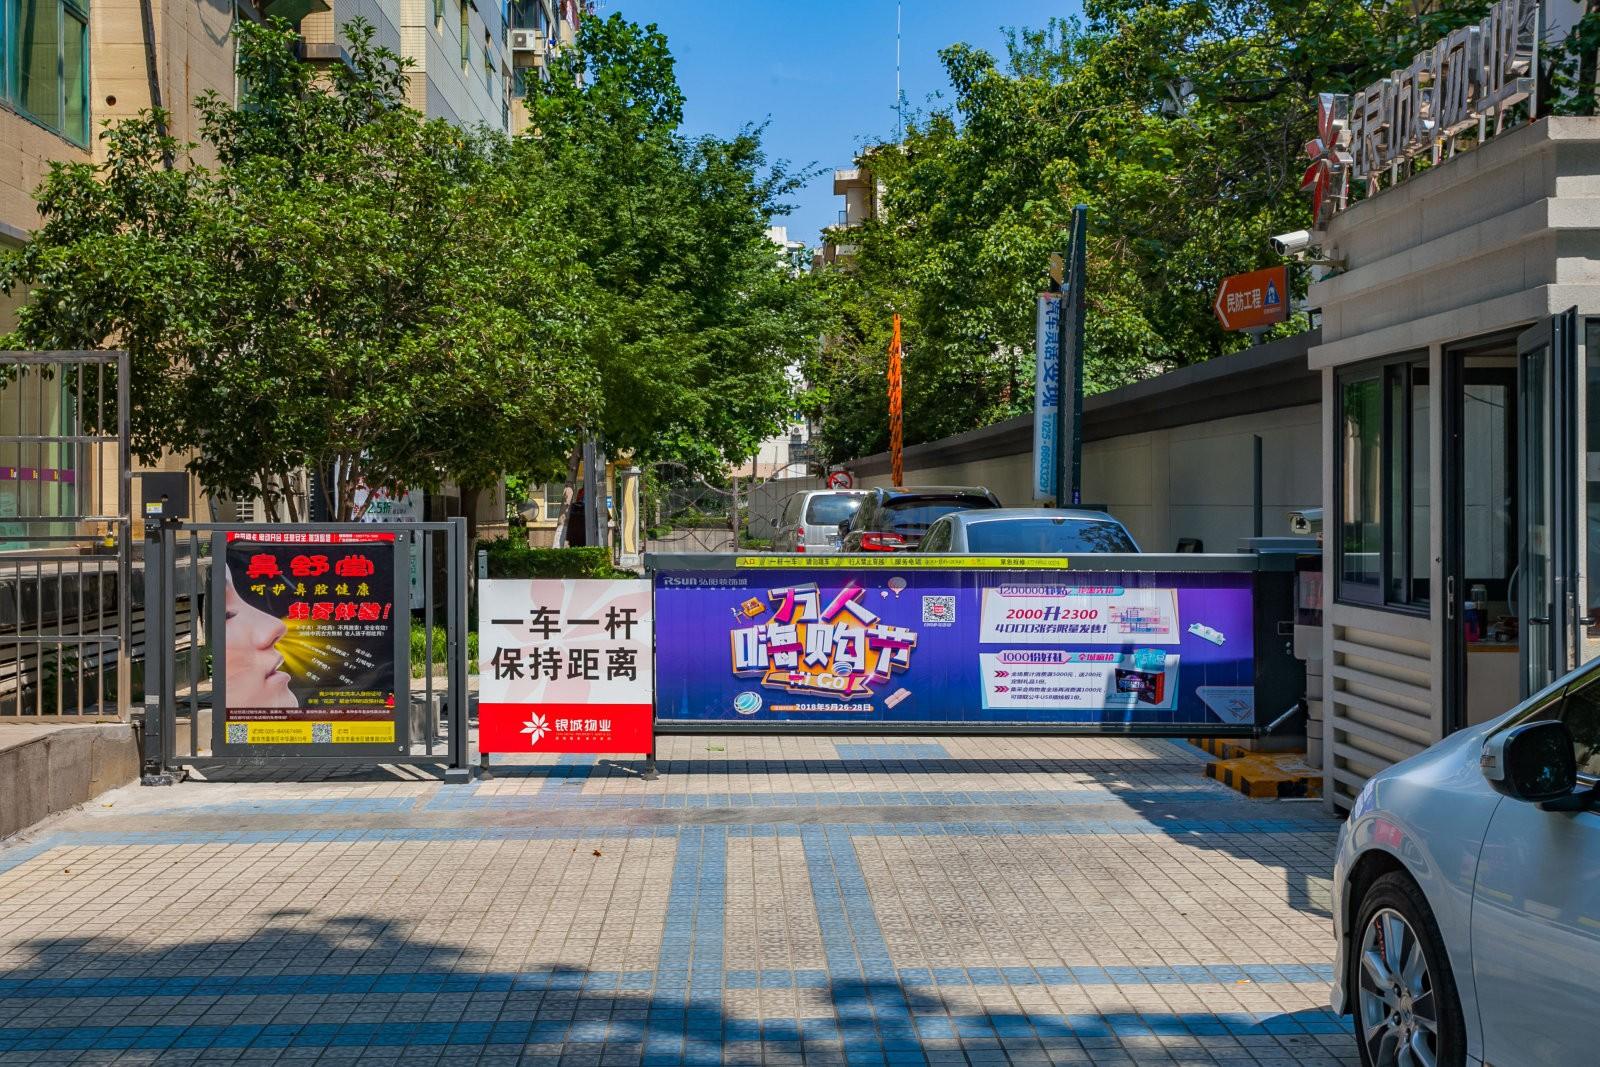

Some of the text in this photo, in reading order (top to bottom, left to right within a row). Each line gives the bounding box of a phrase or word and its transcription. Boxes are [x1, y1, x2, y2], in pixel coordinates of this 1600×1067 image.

[1226, 288, 1262, 313] 民防工程
[1043, 300, 1059, 407] 汽车灵活变现
[246, 553, 375, 579] 鼻舒堂
[894, 558, 922, 566] 服务电话
[250, 582, 370, 597] 呵护鼻腔健康
[287, 602, 392, 621] 免费体验！
[768, 584, 880, 624] 万人
[1006, 606, 1098, 621] 2000升2300
[491, 606, 638, 640] 一车一杆
[995, 624, 1107, 633] 4000张券限量发售！
[732, 623, 917, 674] 嗨购节
[1003, 652, 1062, 662] 1000份好礼
[491, 647, 638, 682] 保持距离
[795, 703, 871, 711] 2018年5月26-28日
[555, 718, 612, 732] 银城物业
